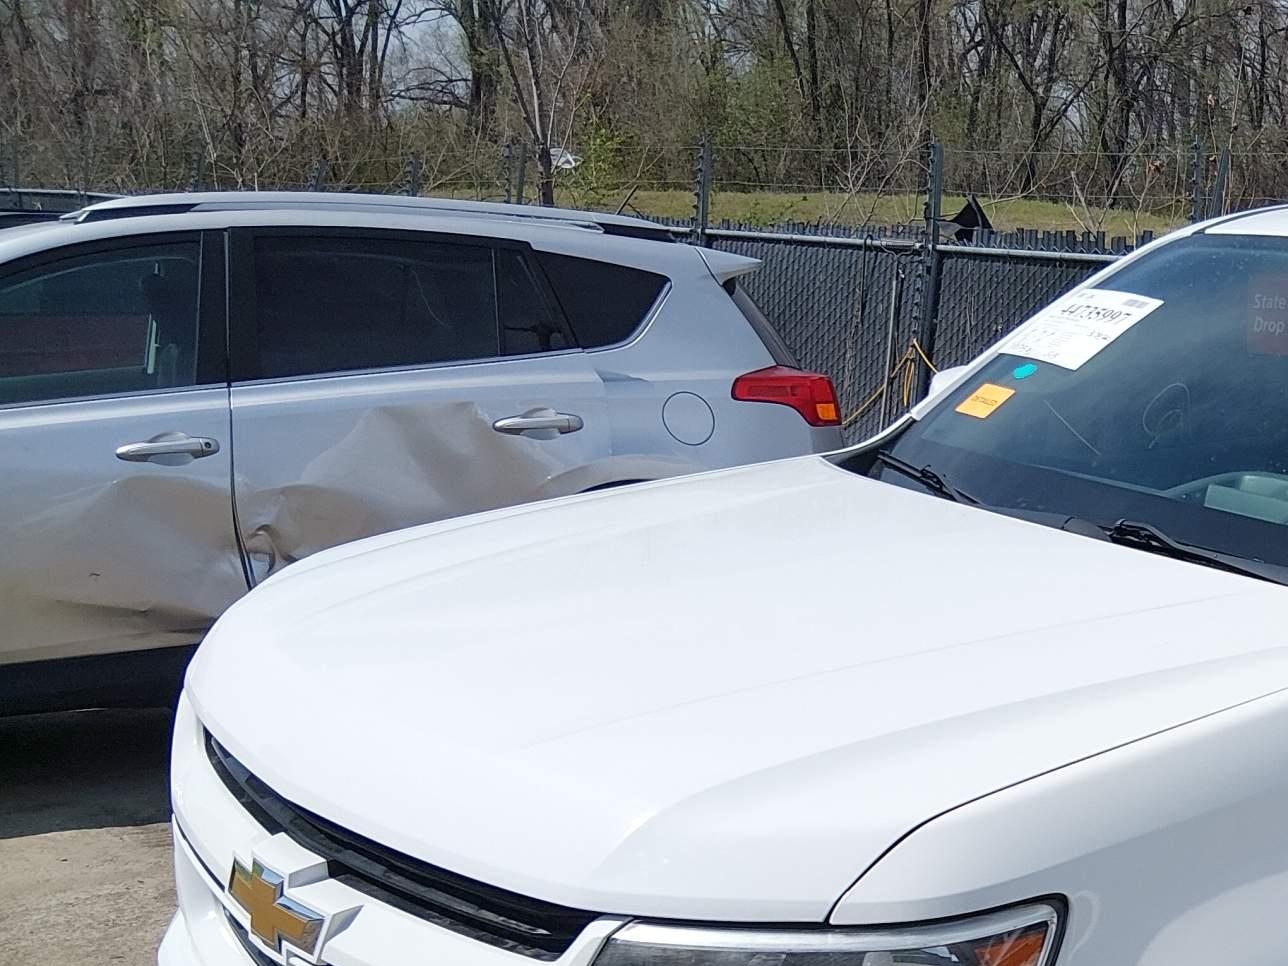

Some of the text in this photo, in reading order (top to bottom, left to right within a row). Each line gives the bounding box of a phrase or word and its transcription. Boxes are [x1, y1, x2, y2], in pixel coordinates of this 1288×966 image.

[1252, 294, 1286, 310] State
[1061, 303, 1132, 325] 44735997
[1253, 316, 1283, 336] Drop
